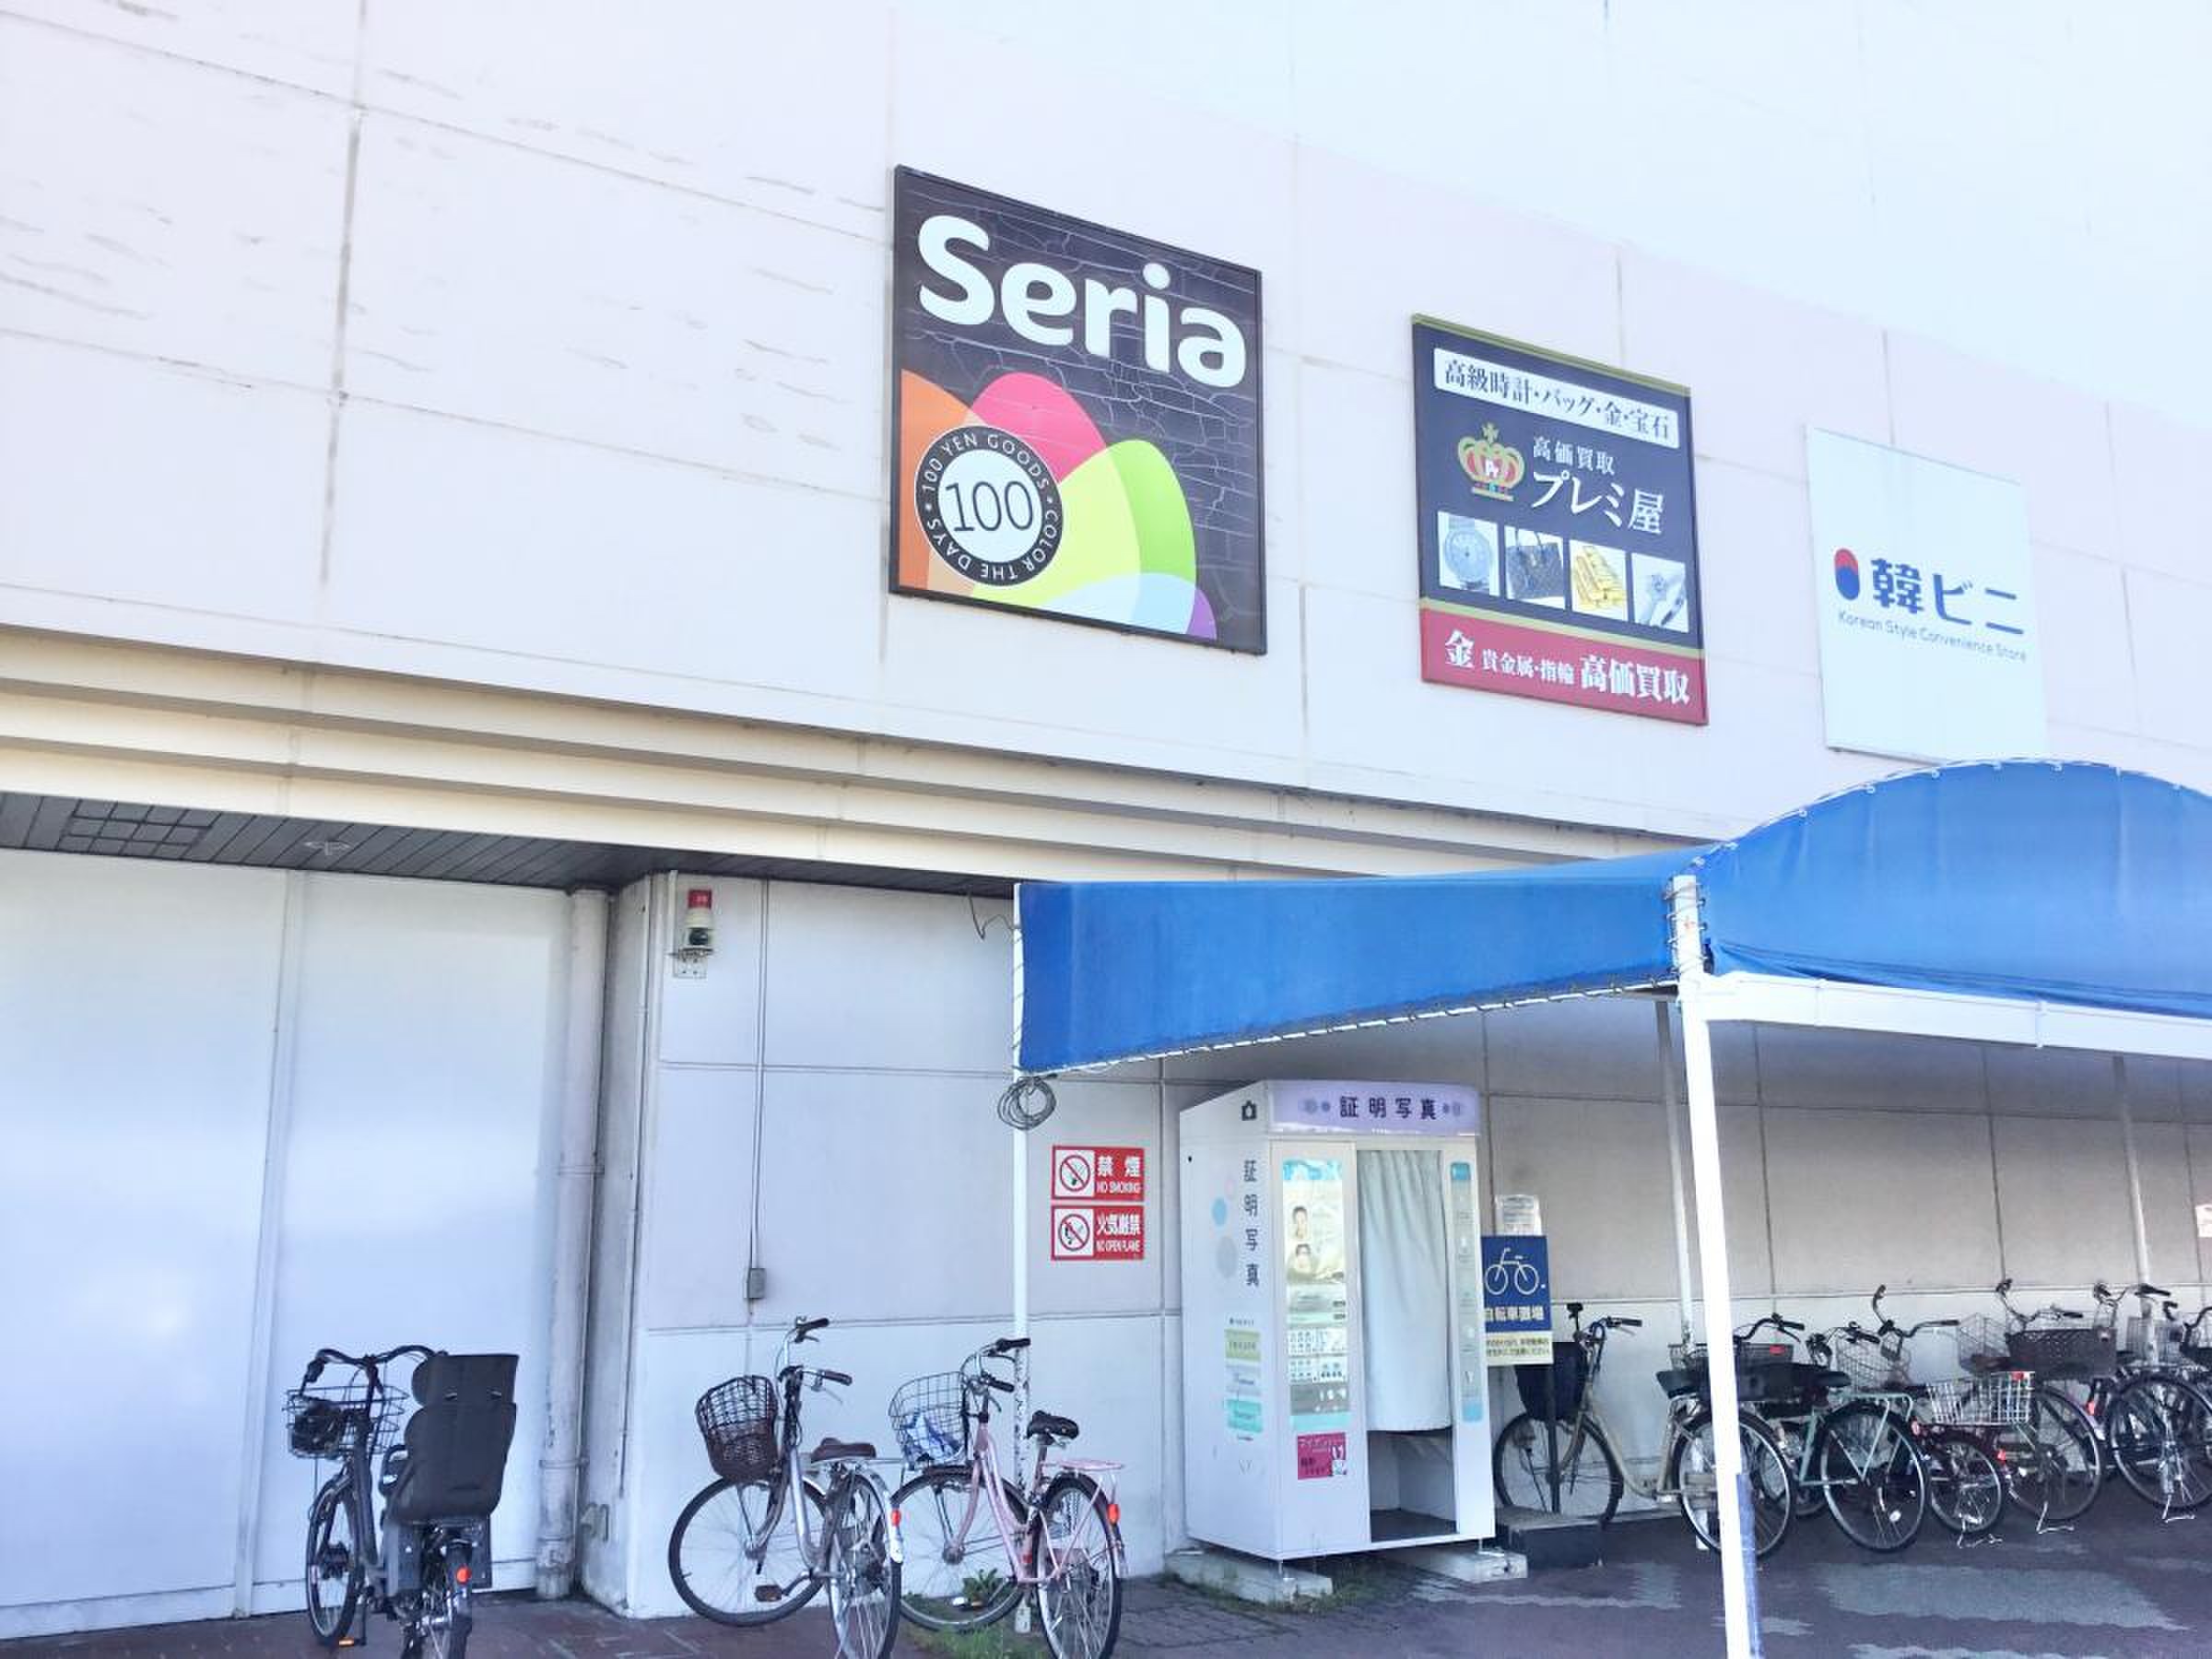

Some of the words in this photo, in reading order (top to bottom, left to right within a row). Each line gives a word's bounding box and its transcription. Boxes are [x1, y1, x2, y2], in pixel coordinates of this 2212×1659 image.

[918, 215, 1247, 388] Seria
[923, 458, 943, 491] 100
[941, 433, 978, 456] YEN
[987, 433, 1049, 489] GOODS
[1533, 436, 1615, 476] 高価買取
[945, 480, 1033, 532] 100
[1531, 469, 1664, 535] プレミ屋
[927, 517, 971, 571] DAYS
[1022, 509, 1059, 571] COLOR
[980, 563, 1018, 581] THE
[1870, 557, 2025, 635] 韓ビニ
[1838, 609, 1883, 631] Korean
[1884, 619, 1918, 641] Style
[1919, 627, 1994, 653] Convenience
[1995, 641, 2027, 662] Store
[1444, 629, 1475, 668] 金
[1580, 653, 1690, 705] 高価買取
[1340, 1095, 1436, 1120] 証明写真
[1243, 1159, 1259, 1288] 証明写真
